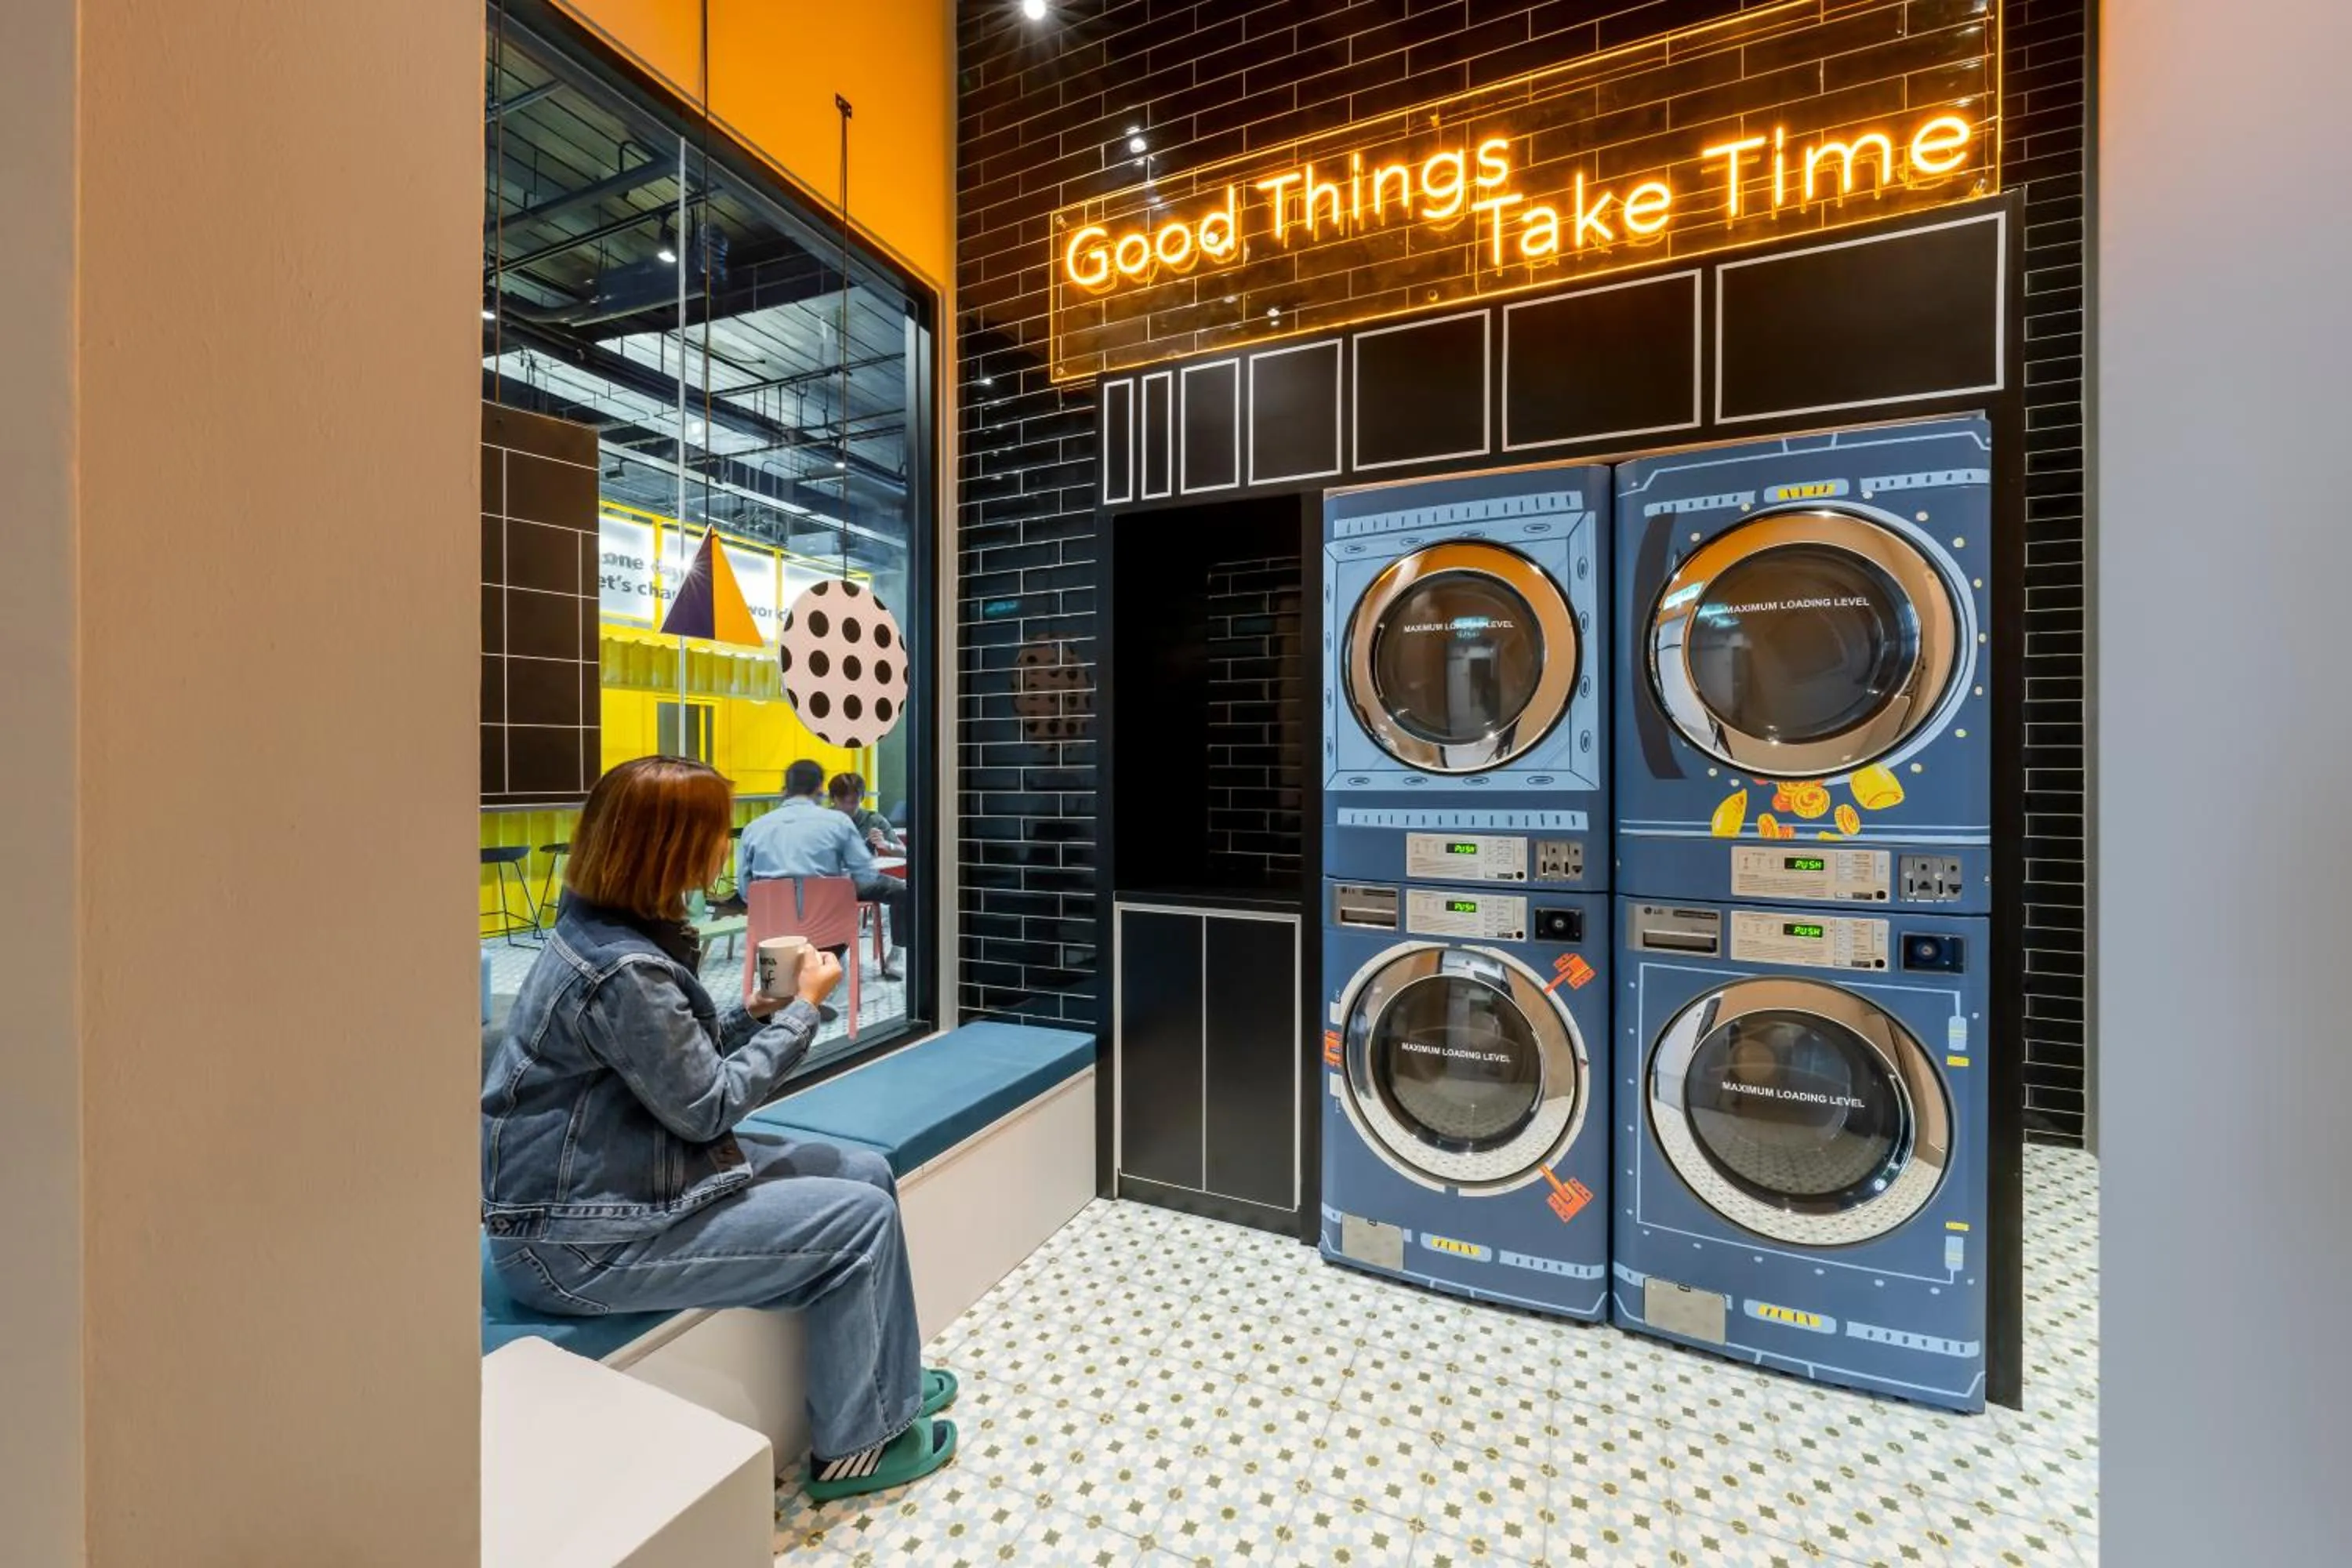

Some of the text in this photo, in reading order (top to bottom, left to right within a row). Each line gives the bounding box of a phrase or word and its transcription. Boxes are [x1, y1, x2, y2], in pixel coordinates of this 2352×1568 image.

[1469, 114, 1973, 267] Take Time
[1065, 136, 1512, 287] Good Things
[1725, 597, 1870, 614] MAXIMUM LOADING LEVEL
[1403, 623, 1443, 633] MAXIMUM
[1795, 860, 1821, 869] PUSH
[1793, 926, 1820, 935] PUSH
[1401, 1042, 1512, 1063] MAXIMUM LOADING LEVEL
[1722, 1081, 1866, 1108] MAXIMUM LOADING LEVEL
